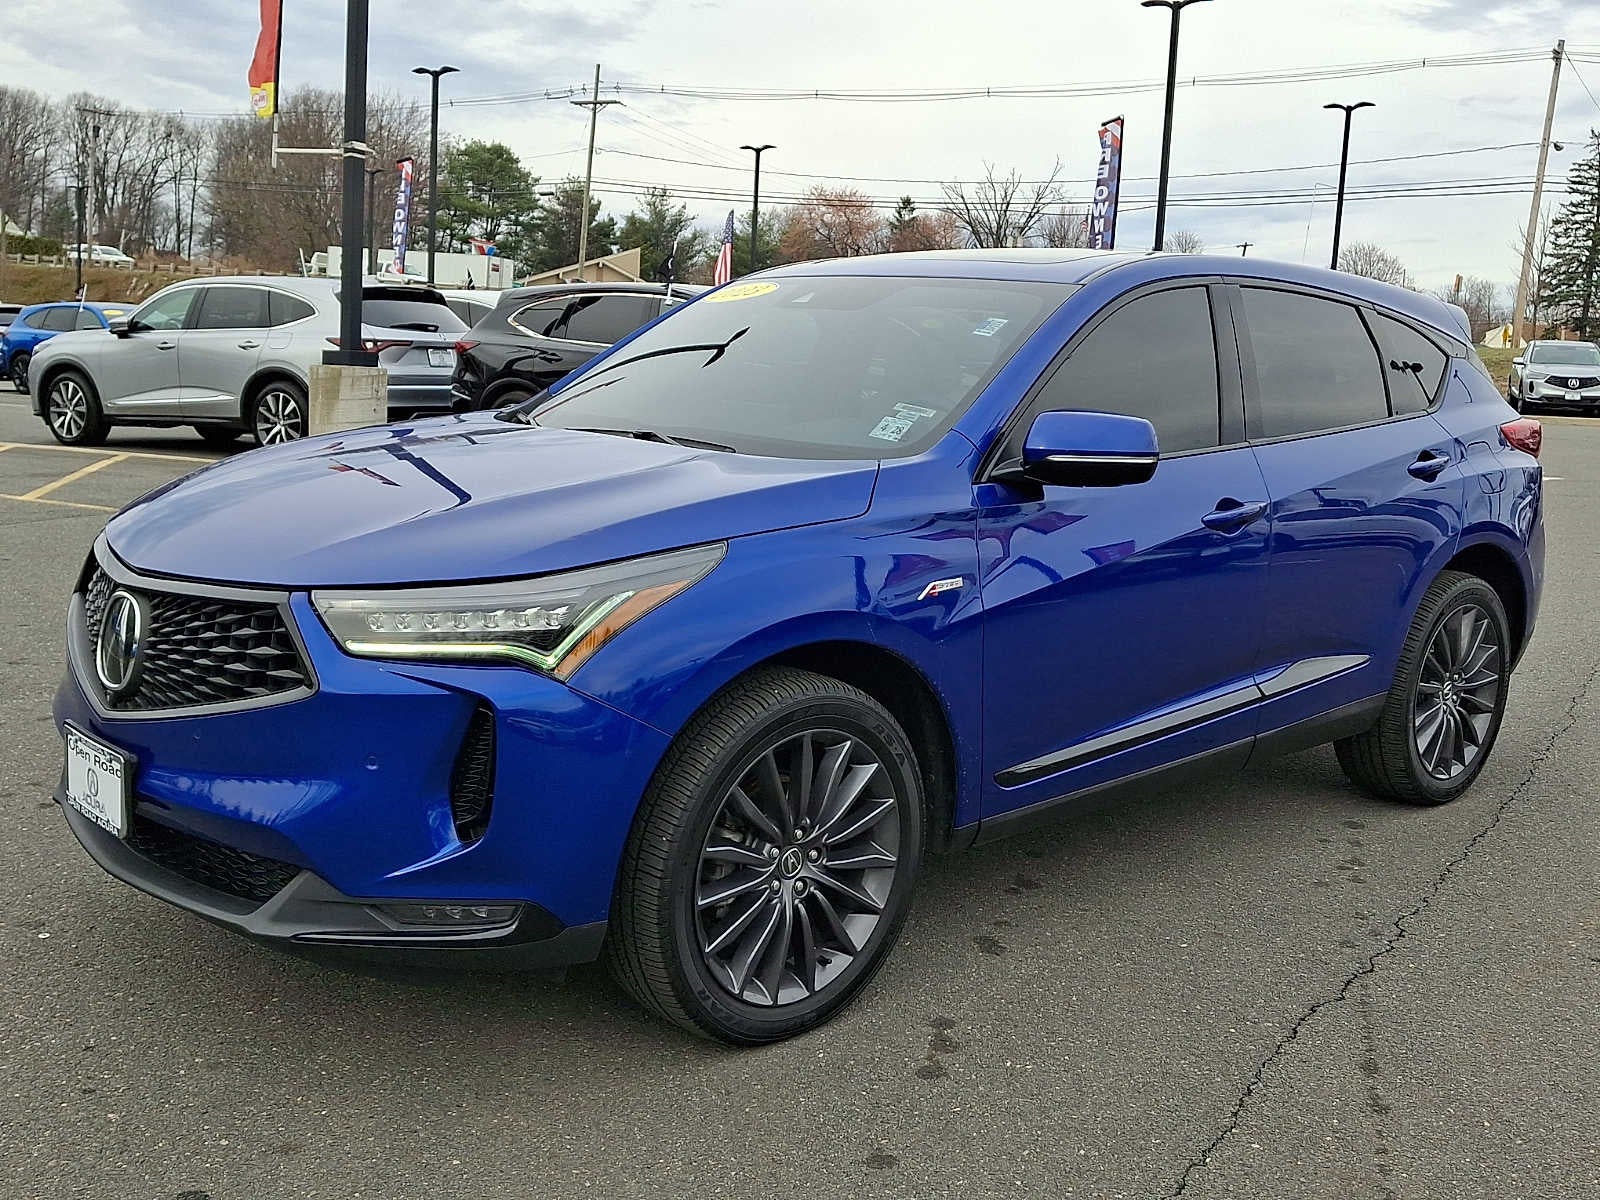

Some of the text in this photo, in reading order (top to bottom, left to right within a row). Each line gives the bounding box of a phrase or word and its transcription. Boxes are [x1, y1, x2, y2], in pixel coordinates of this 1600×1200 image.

[68, 737, 91, 762] Open
[81, 806, 97, 823] ROAD
[97, 818, 119, 837] ACURA
